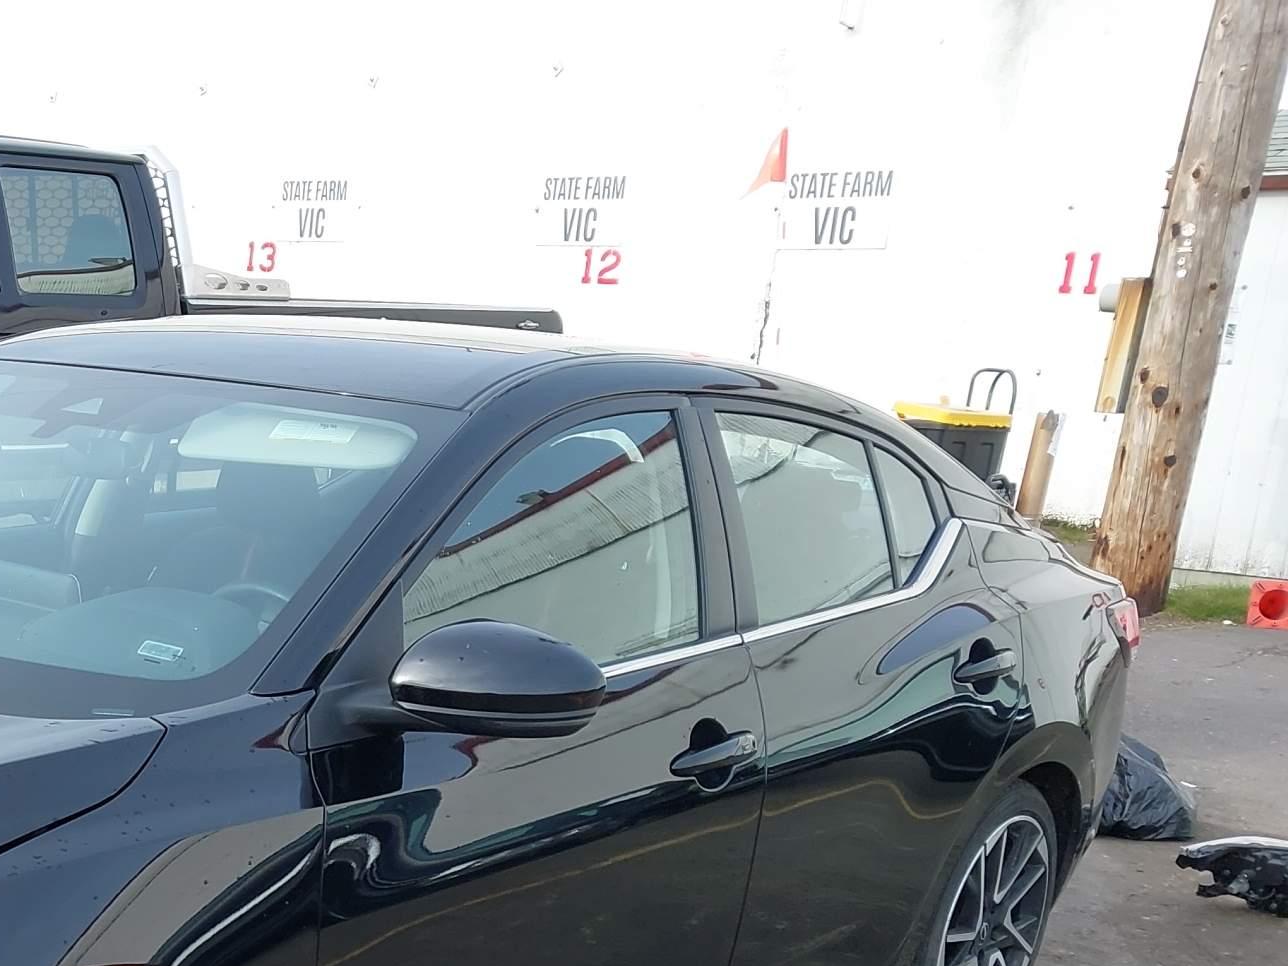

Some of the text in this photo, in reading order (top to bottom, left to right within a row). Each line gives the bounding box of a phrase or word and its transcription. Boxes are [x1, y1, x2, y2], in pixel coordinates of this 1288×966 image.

[282, 180, 347, 201] STATE FARM
[544, 176, 626, 200] STATE FARM
[789, 170, 894, 199] STATE FARM
[299, 207, 325, 238] VIC
[563, 208, 597, 242] VIC
[814, 206, 856, 245] VIC
[247, 241, 277, 273] 13
[581, 248, 622, 285] 12
[1058, 252, 1101, 295] 11
